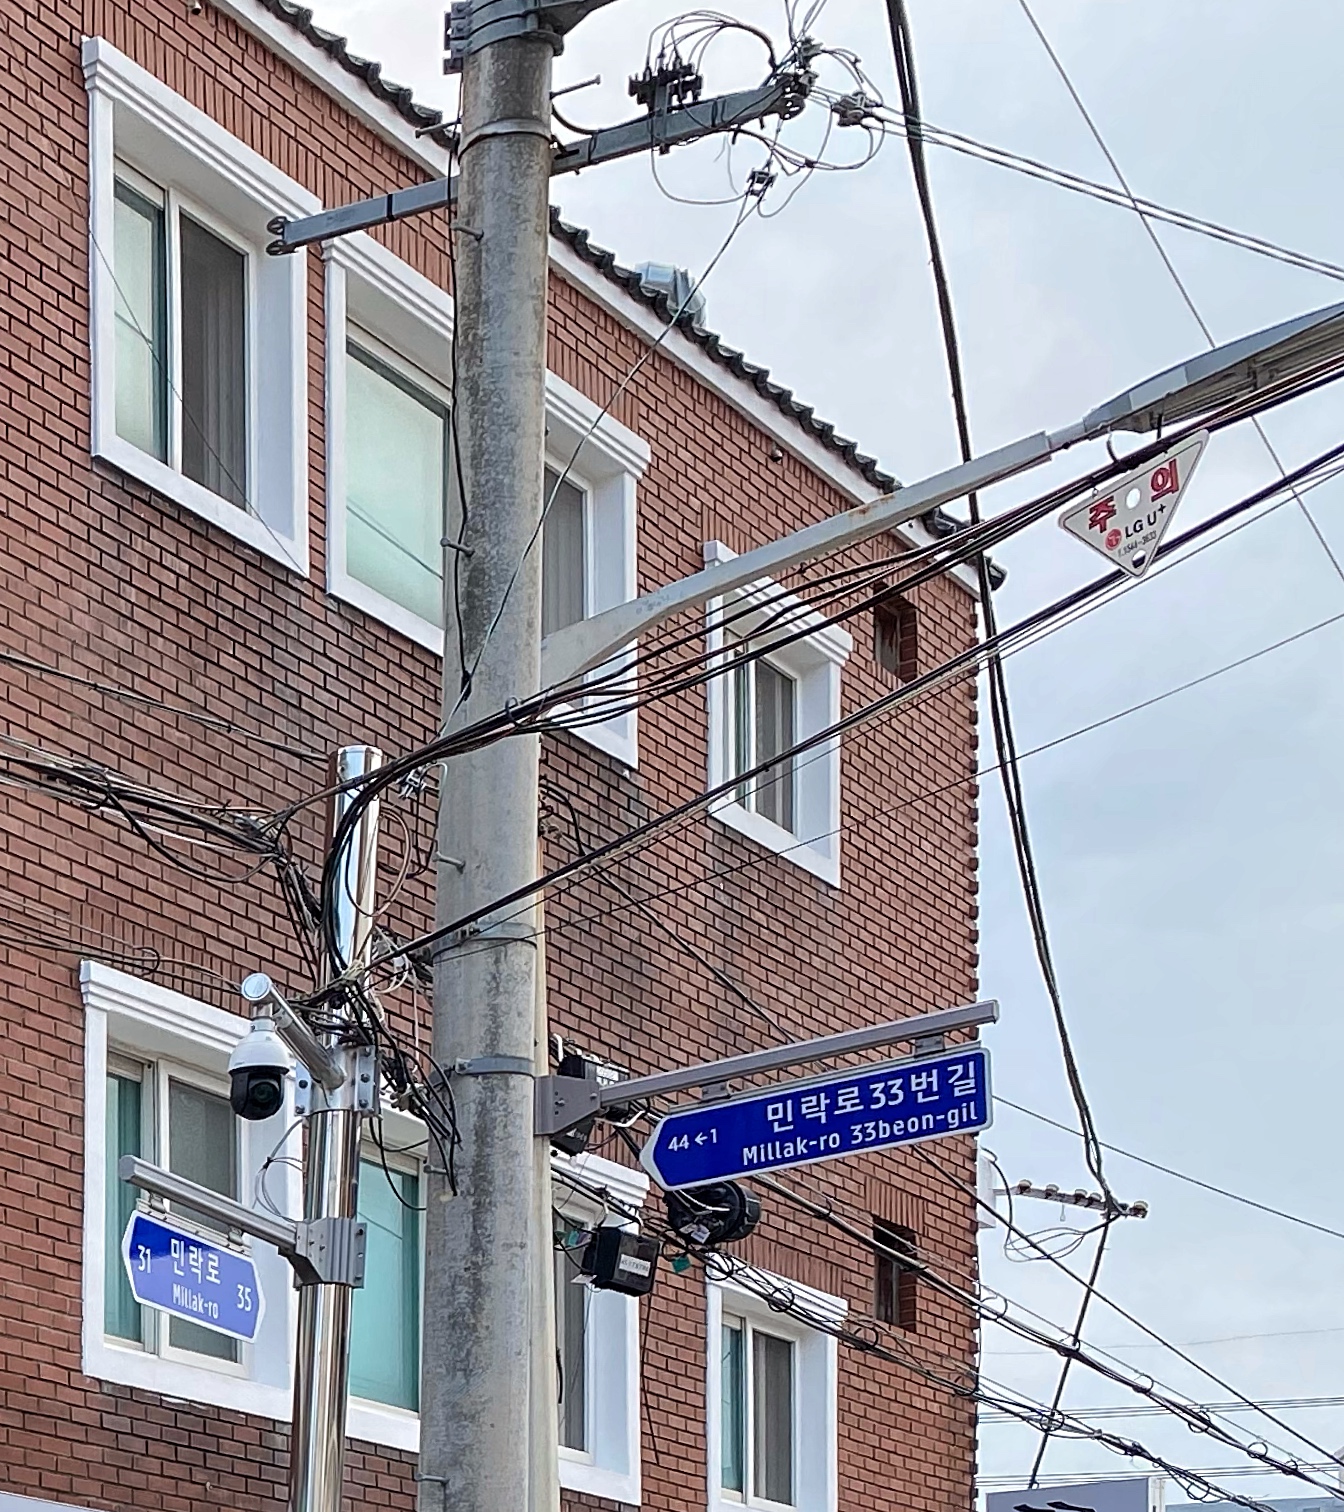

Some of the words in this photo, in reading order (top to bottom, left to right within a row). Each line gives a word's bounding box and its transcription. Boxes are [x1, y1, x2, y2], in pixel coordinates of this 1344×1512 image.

[1089, 458, 1179, 534] 주의
[1124, 519, 1144, 539] LG
[767, 1060, 977, 1134] 민락로33번길
[668, 1136, 690, 1153] 44
[742, 1131, 841, 1166] Millak-ro
[850, 1102, 978, 1147] 33beon-gil
[137, 1244, 152, 1274] 31
[170, 1238, 221, 1285] 민락로
[172, 1282, 219, 1320] Millak-ro
[236, 1284, 252, 1312] 35
